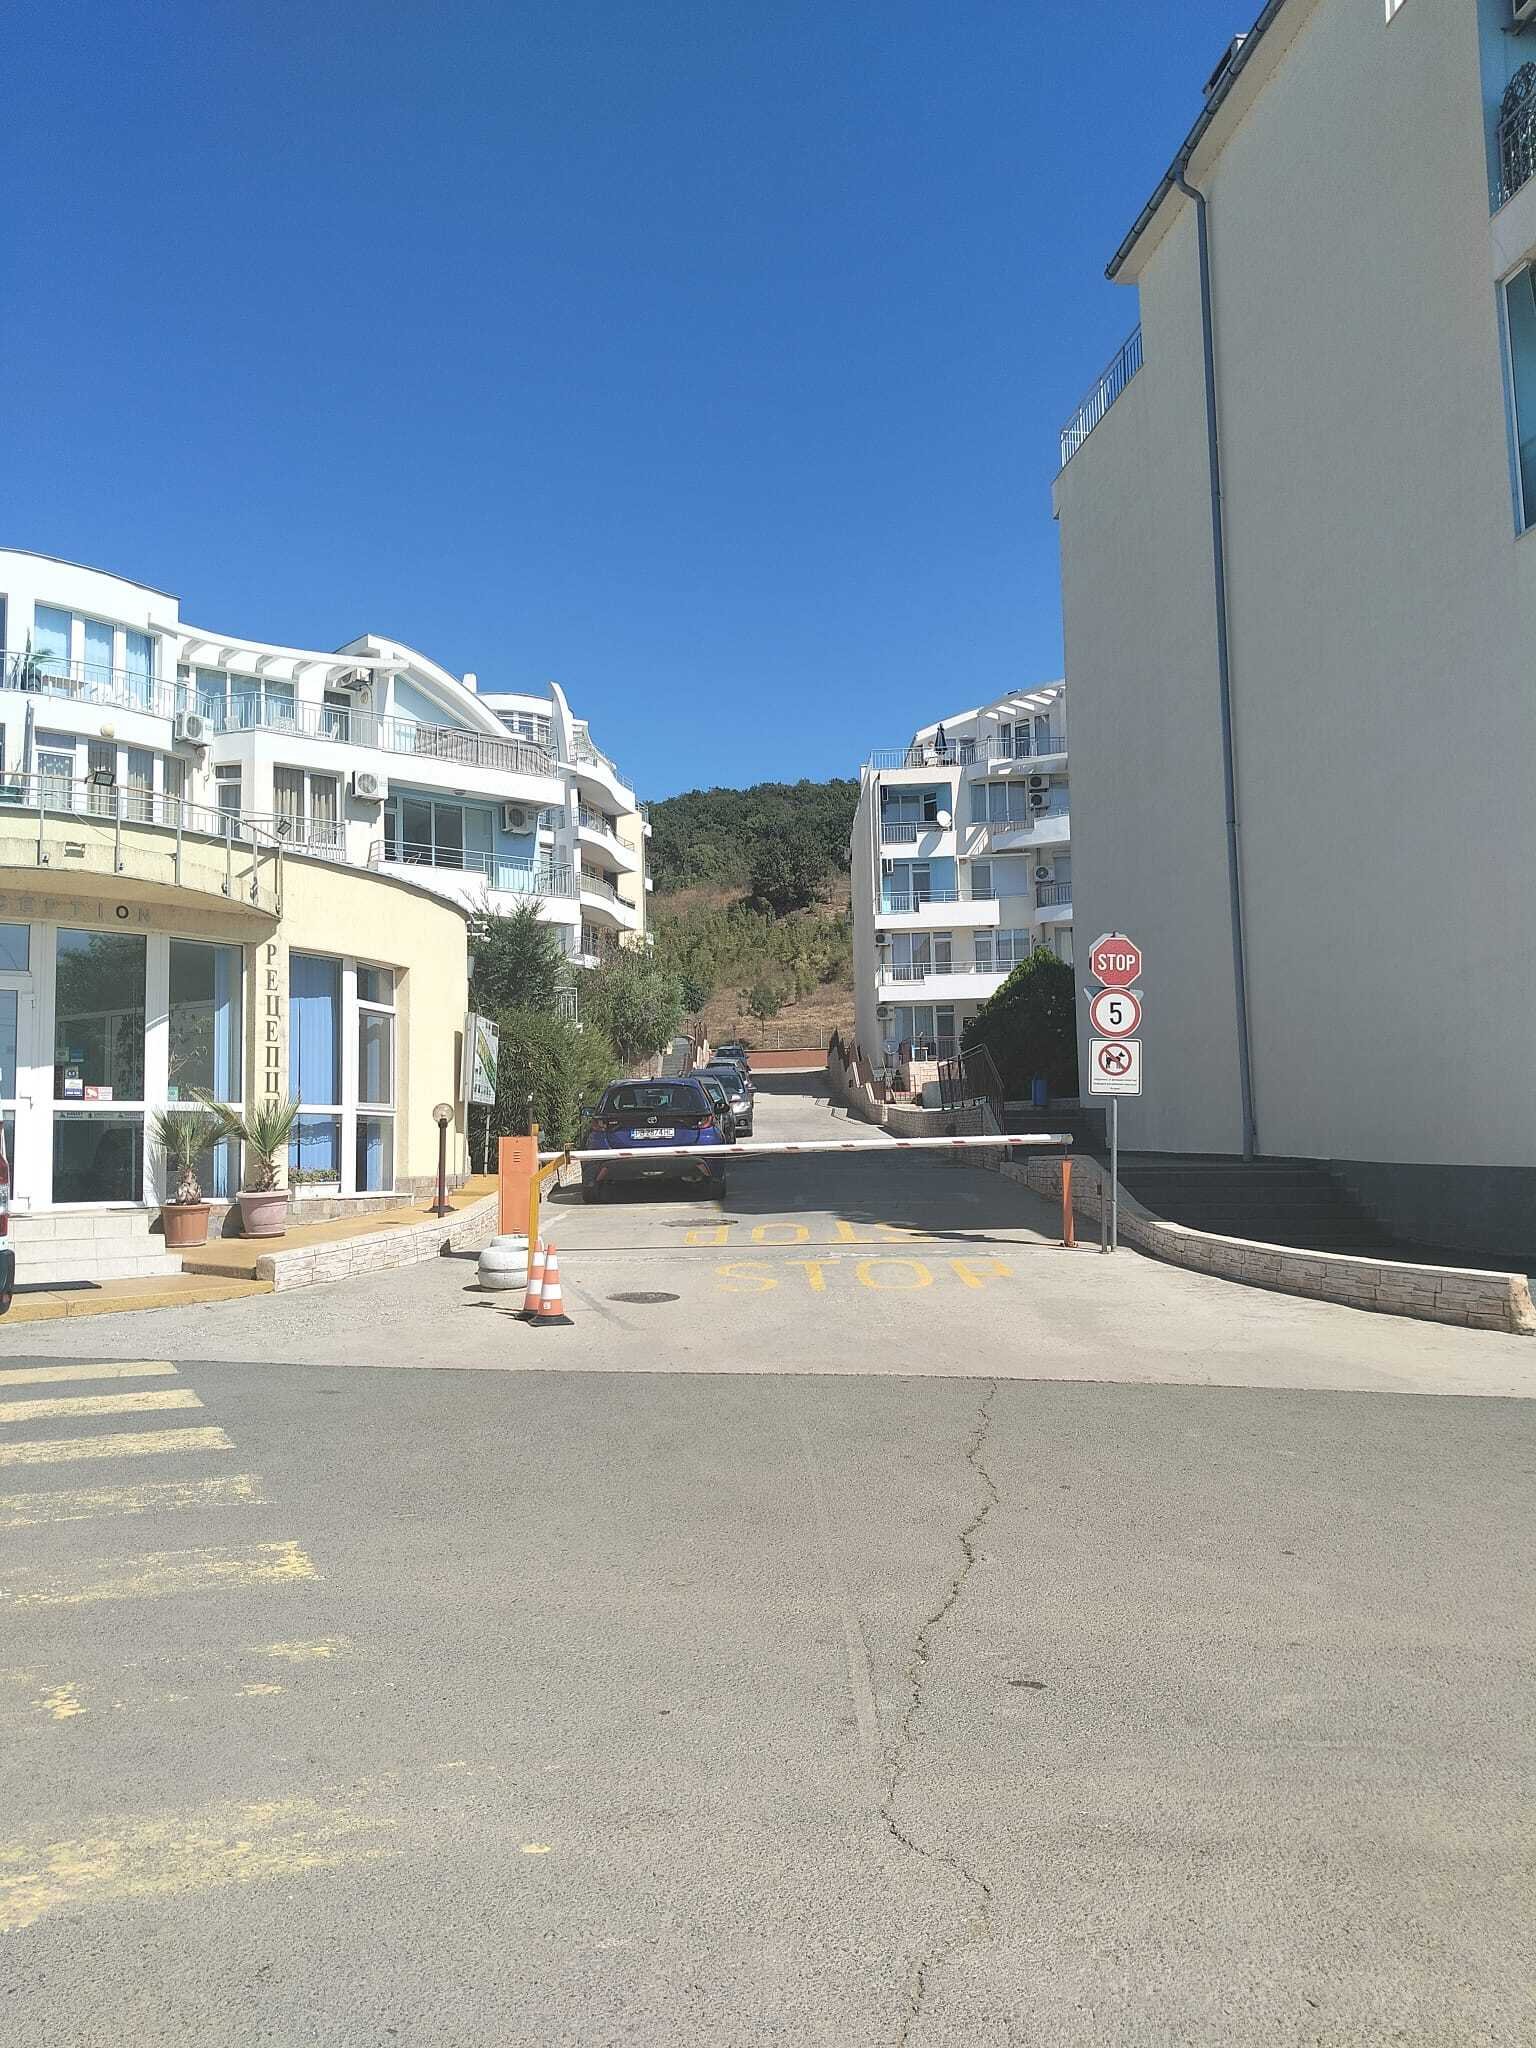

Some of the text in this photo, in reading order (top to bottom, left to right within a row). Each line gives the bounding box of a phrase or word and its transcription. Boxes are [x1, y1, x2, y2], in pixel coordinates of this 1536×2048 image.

[1098, 954, 1135, 971] STOP
[1109, 1002, 1122, 1025] 5
[715, 1259, 1014, 1293] STOP
